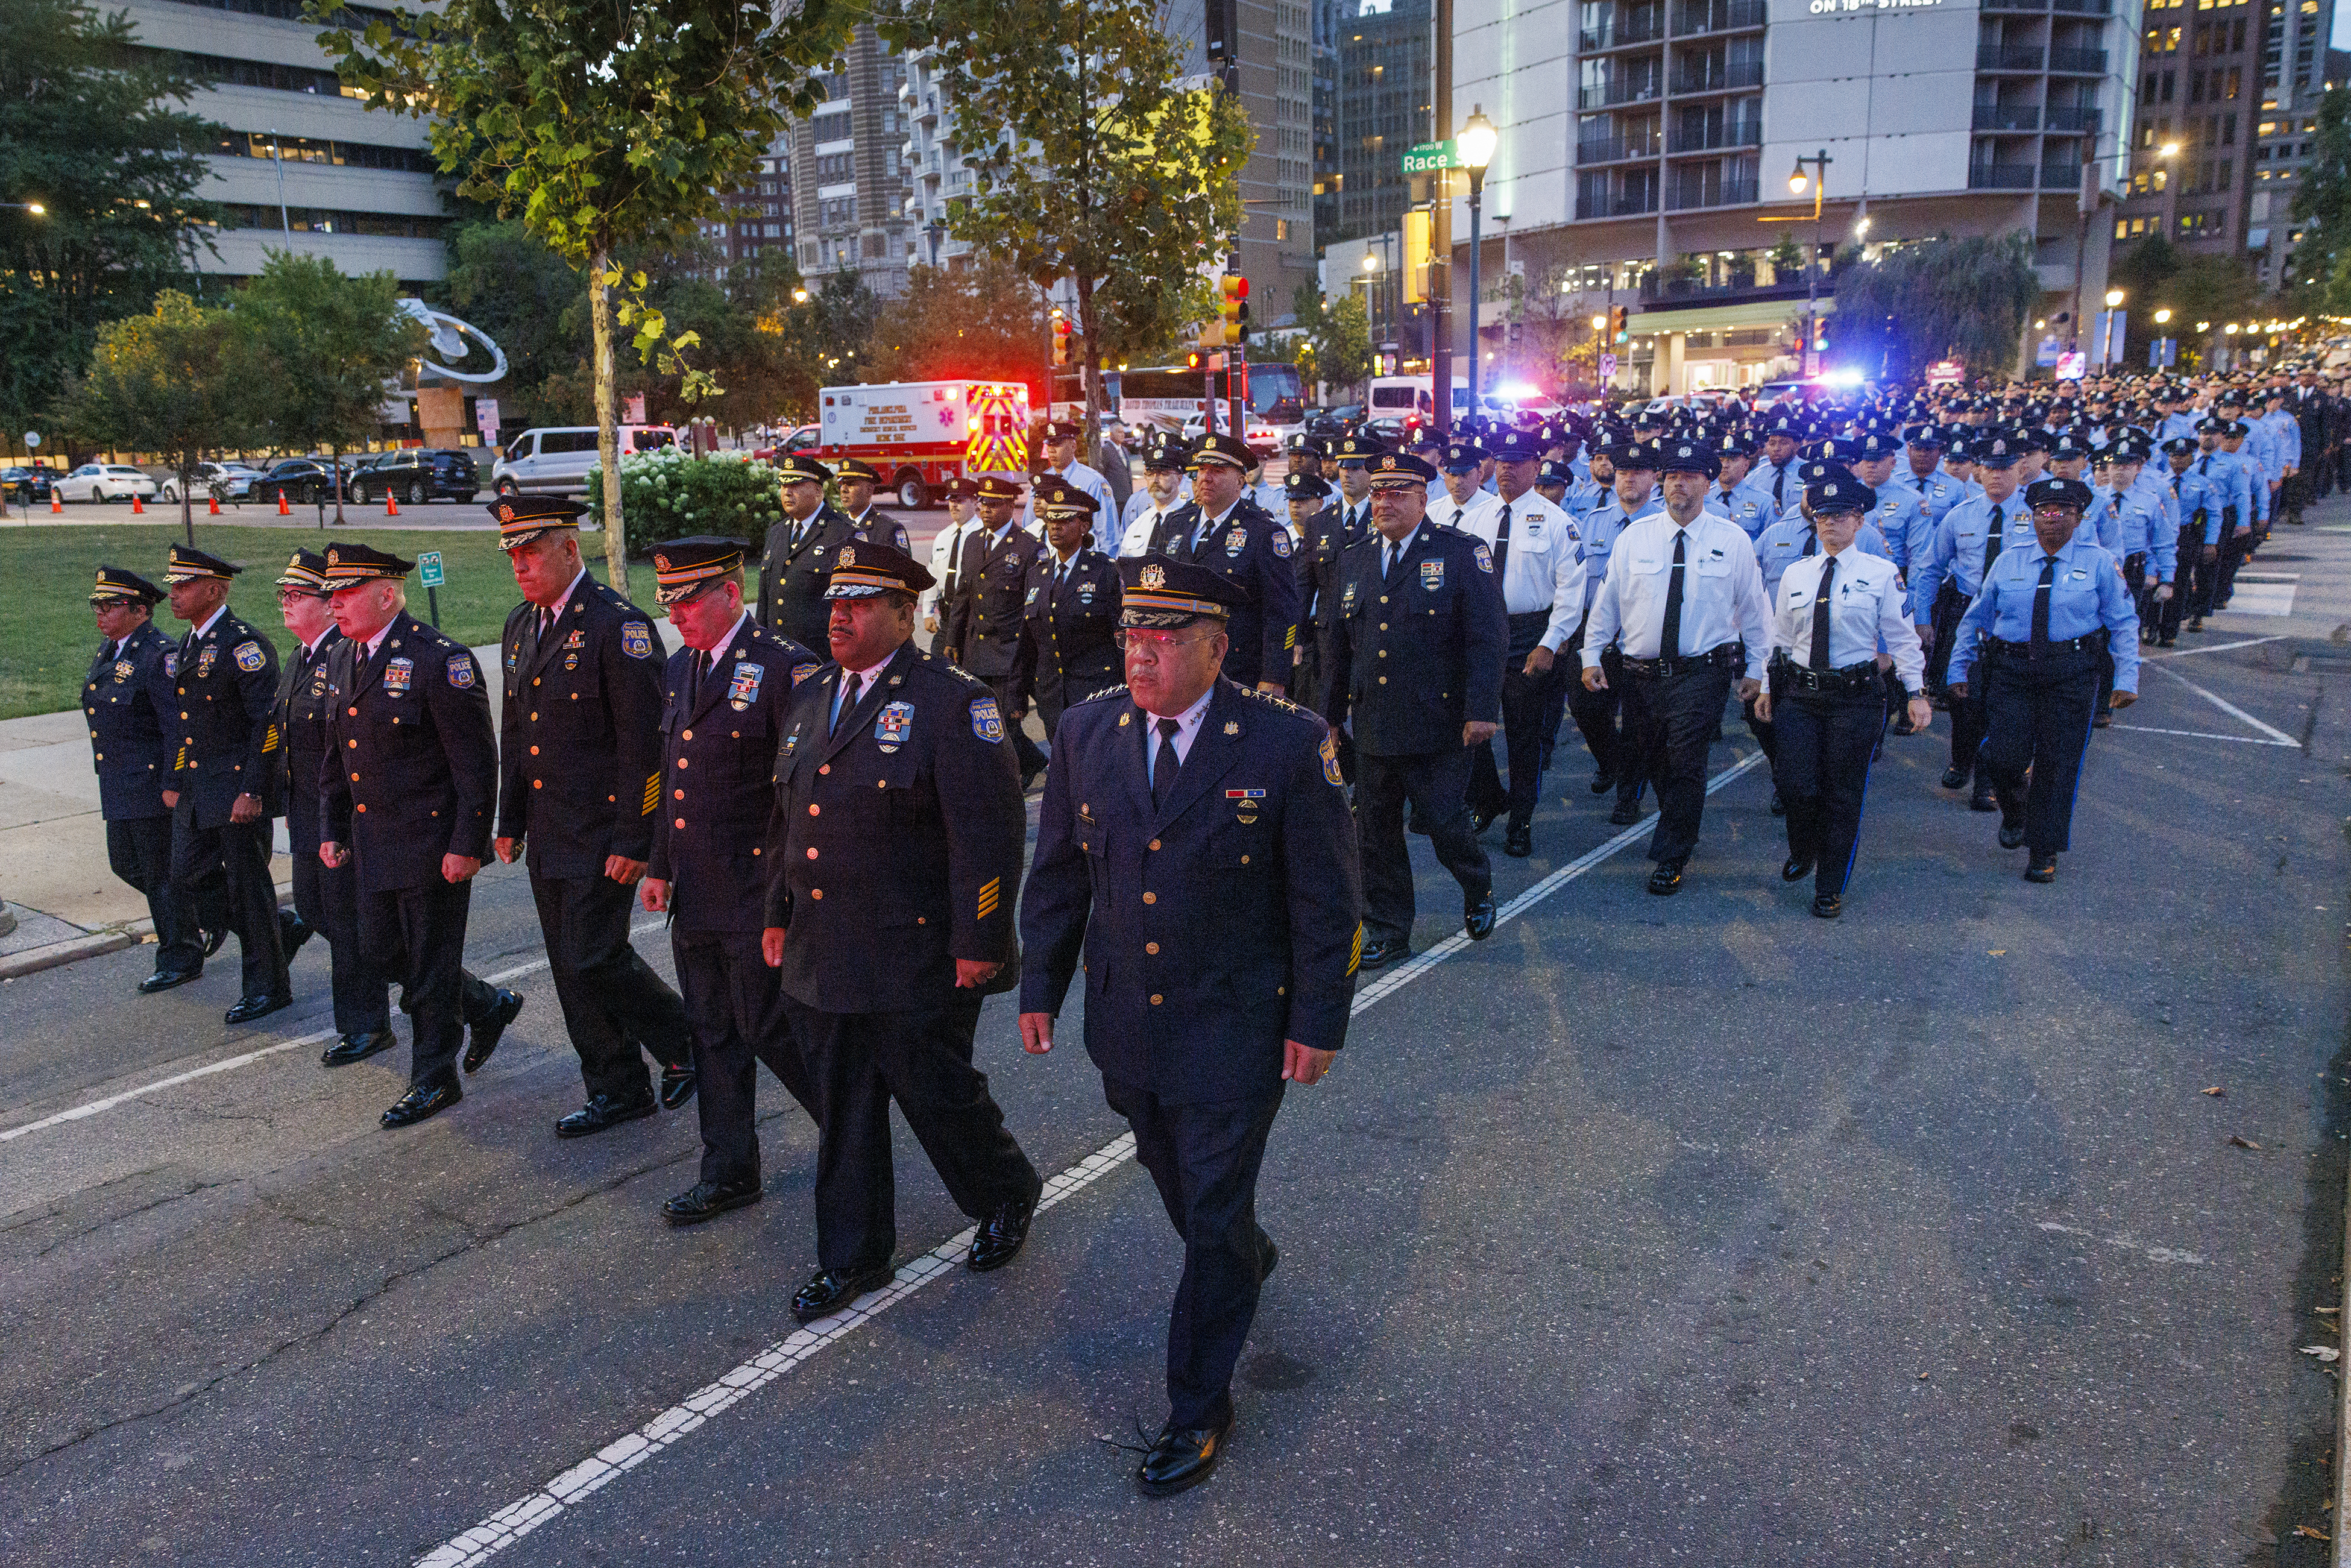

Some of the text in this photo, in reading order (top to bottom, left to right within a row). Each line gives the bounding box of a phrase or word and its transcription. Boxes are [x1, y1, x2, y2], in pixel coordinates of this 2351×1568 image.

[1810, 0, 1836, 14] ON
[1435, 141, 1443, 150] W
[1403, 154, 1448, 171] Race
[625, 630, 649, 640] POLICE
[238, 646, 259, 661] POLICE
[450, 661, 471, 673] POLICE
[974, 708, 999, 722] POLICE
